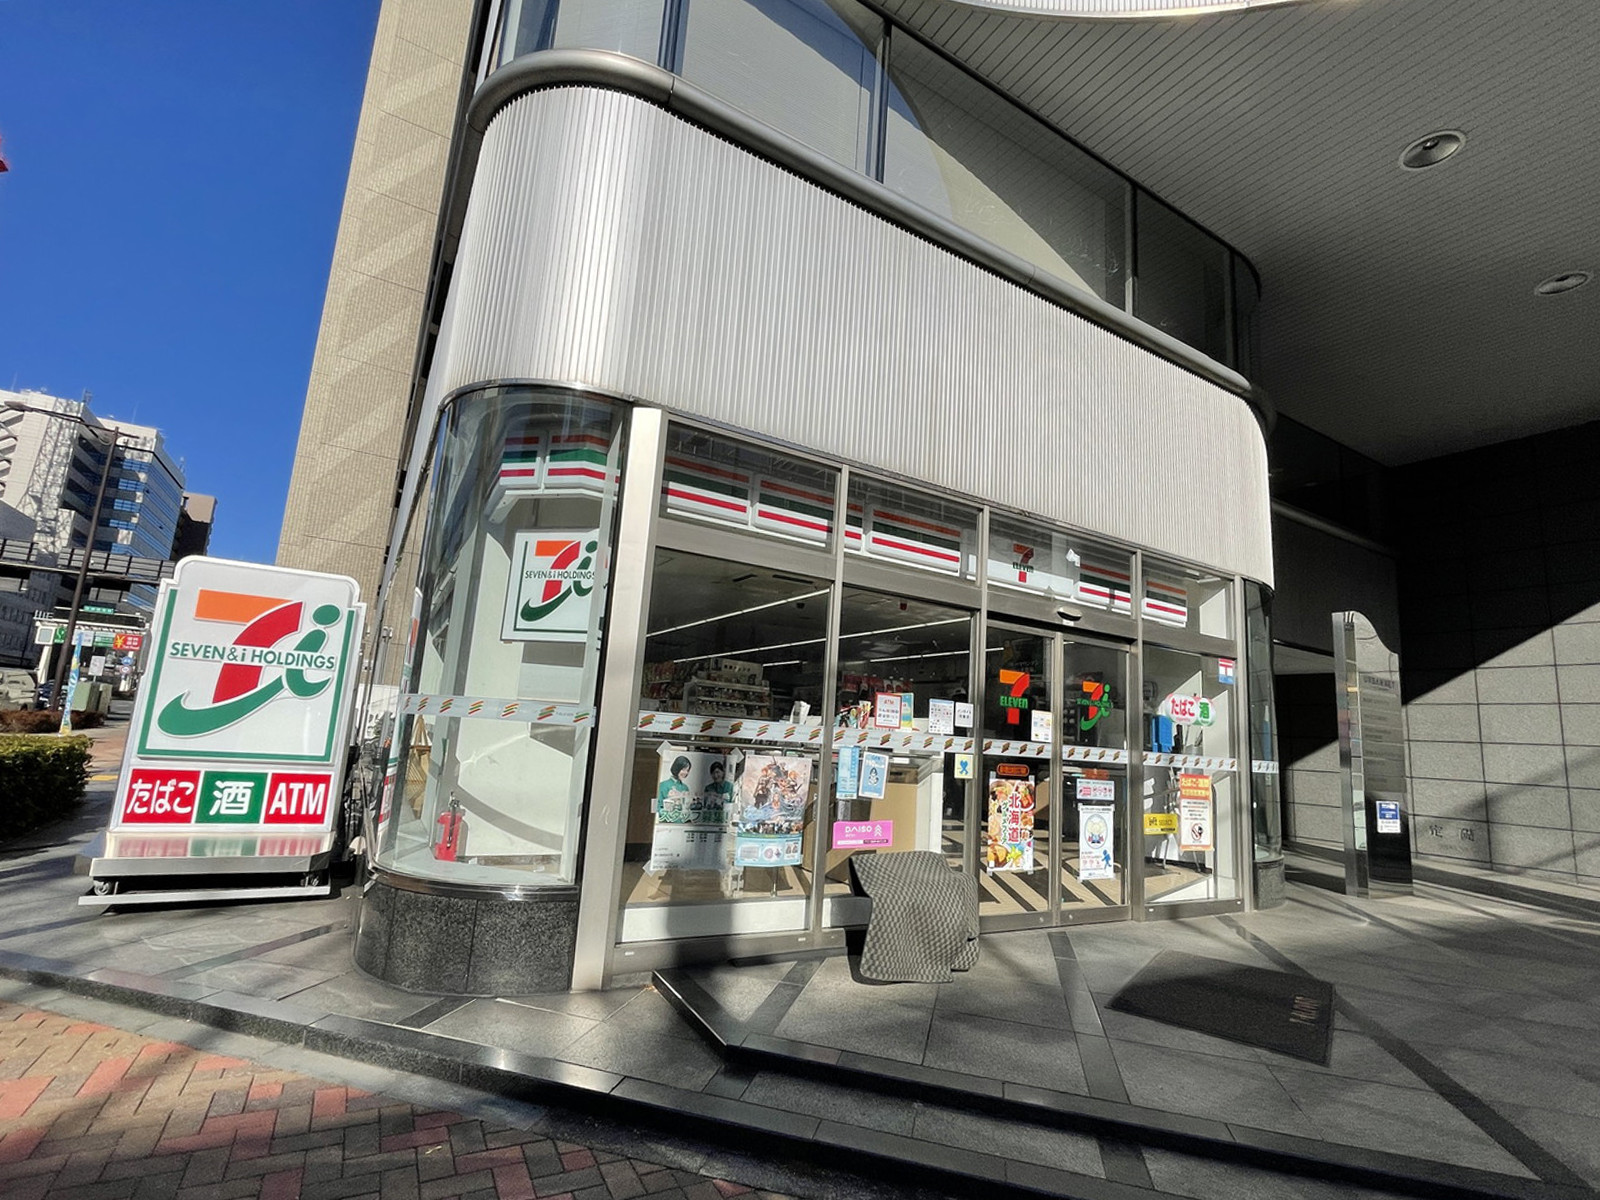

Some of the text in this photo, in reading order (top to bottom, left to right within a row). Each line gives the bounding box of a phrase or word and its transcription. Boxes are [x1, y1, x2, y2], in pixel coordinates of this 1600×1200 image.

[251, 651, 335, 670] HOLDINGS
[1170, 698, 1195, 717] たばこ
[126, 779, 325, 816] たばこ 酒 ATM
[1008, 793, 1020, 843] 北海道
[845, 825, 873, 834] DAISO
